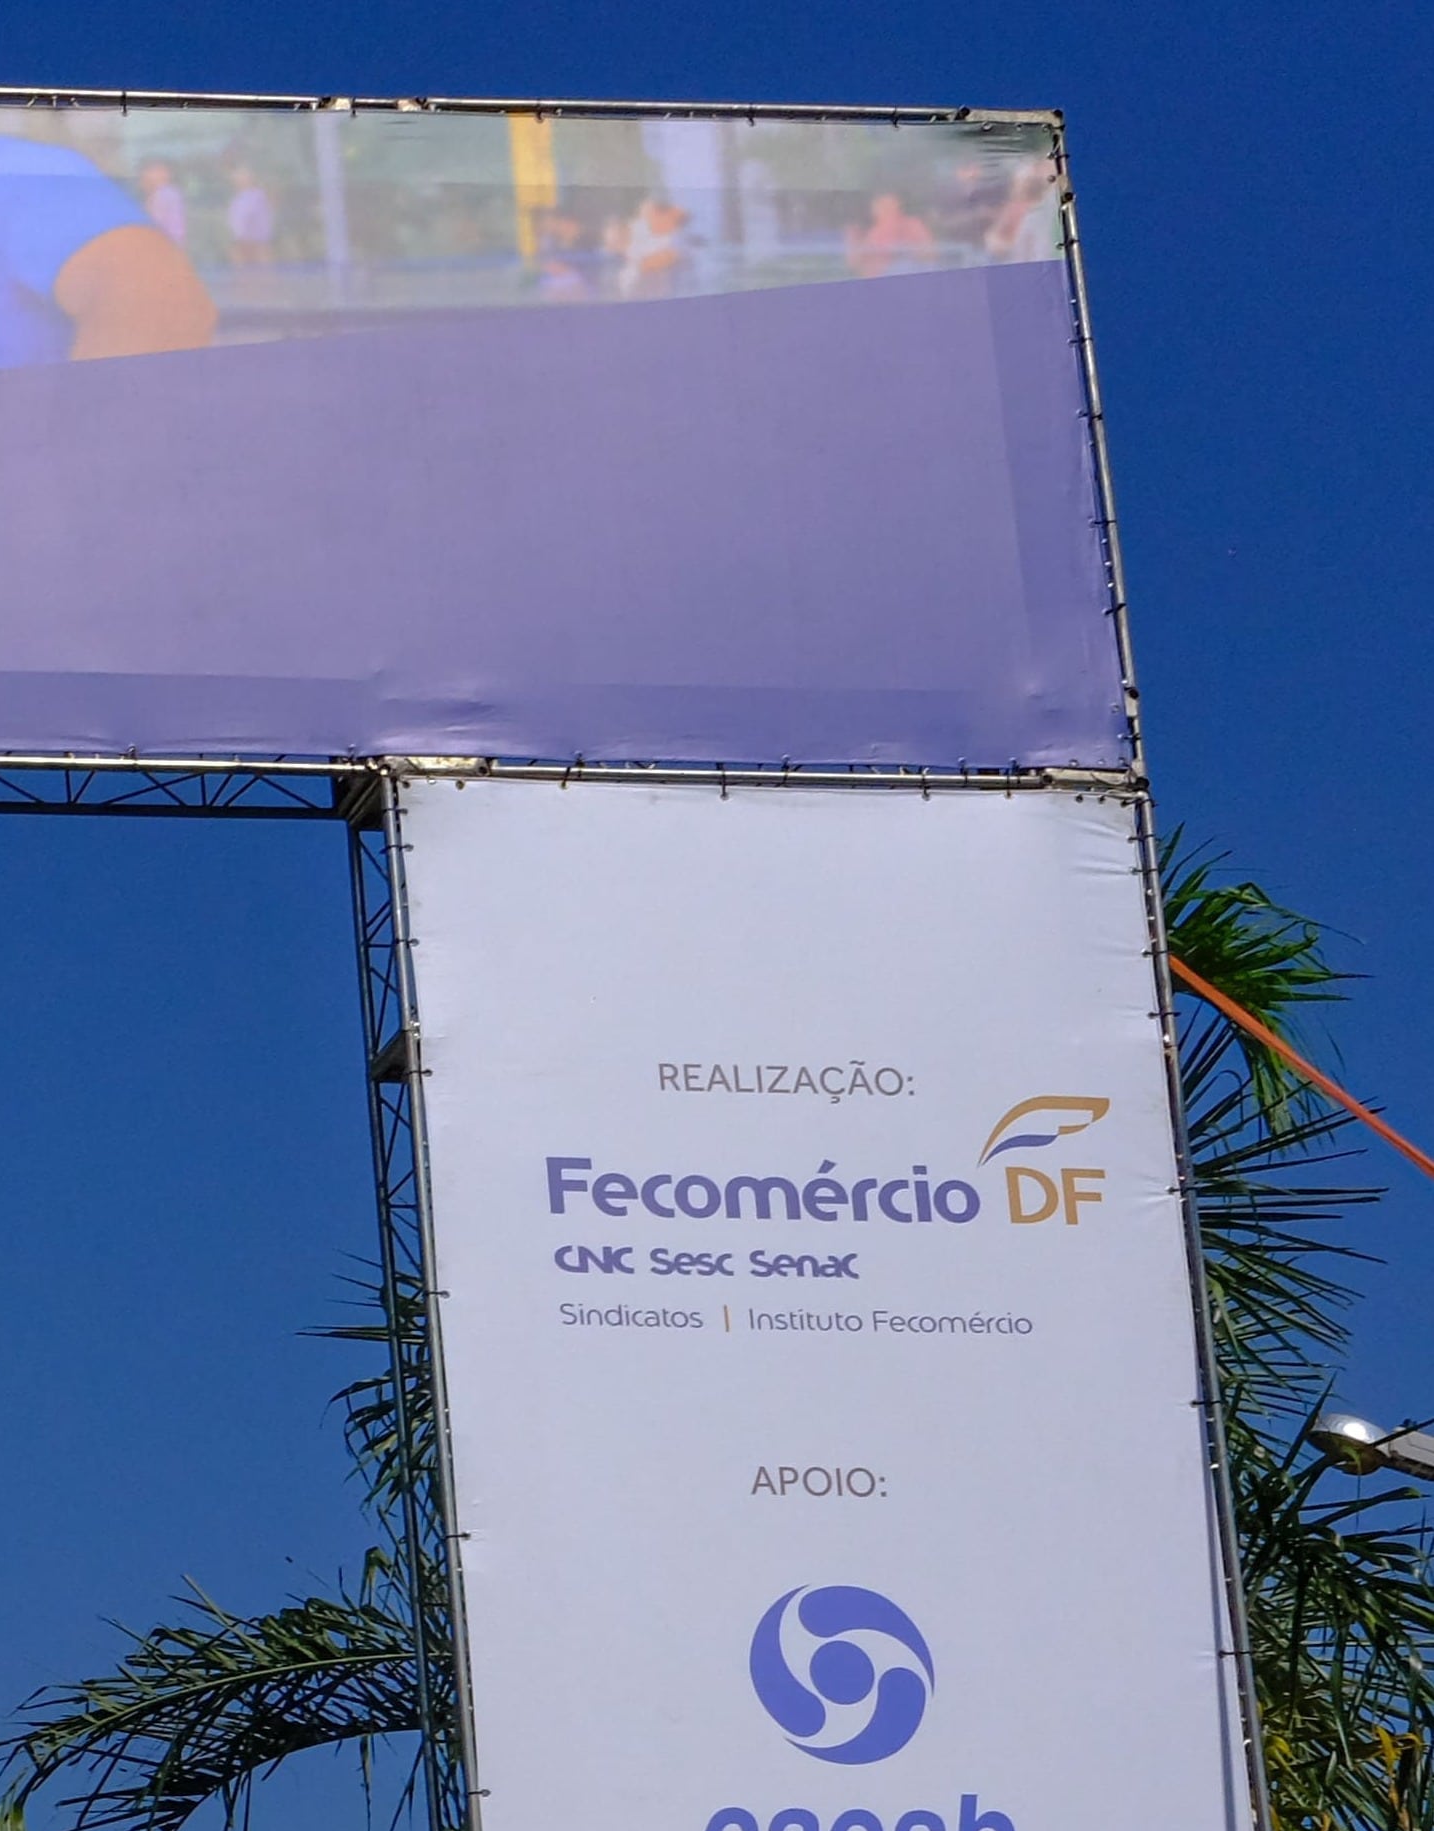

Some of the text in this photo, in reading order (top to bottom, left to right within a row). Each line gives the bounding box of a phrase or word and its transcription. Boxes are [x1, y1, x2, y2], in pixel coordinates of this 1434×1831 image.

[659, 1061, 914, 1104] REALIZAÇÃO:
[546, 1156, 1105, 1225] Fecomércio DF
[555, 1246, 634, 1274] CNC
[650, 1248, 734, 1276] Sesc
[560, 1304, 1032, 1334] Sindicatos Instituto Fecomércio
[752, 1467, 886, 1497] APOIO:
